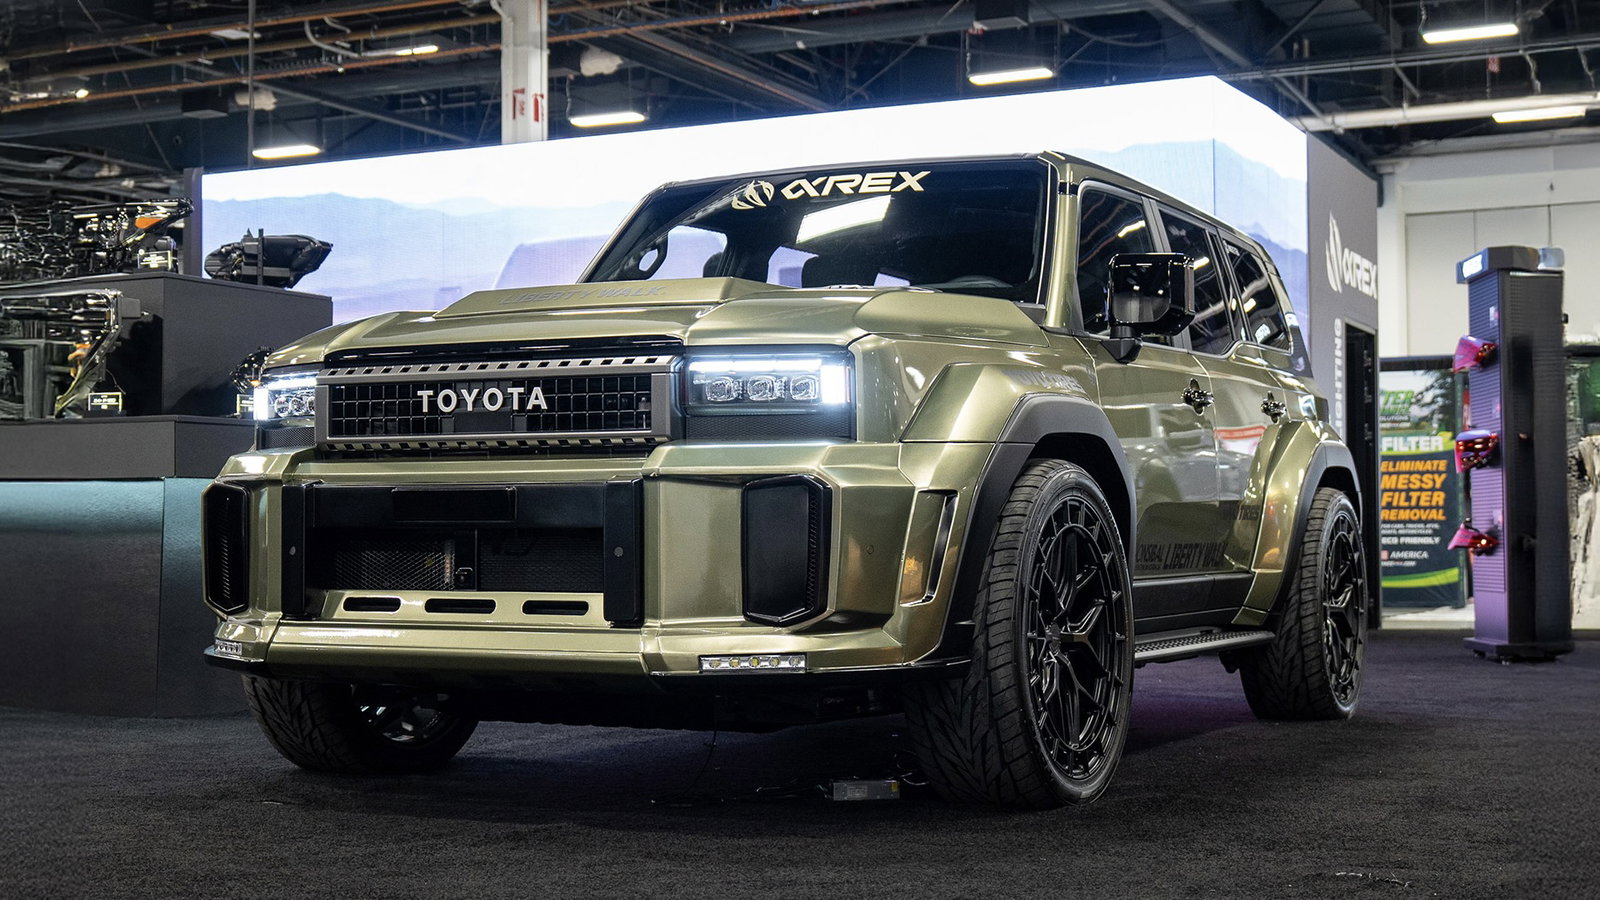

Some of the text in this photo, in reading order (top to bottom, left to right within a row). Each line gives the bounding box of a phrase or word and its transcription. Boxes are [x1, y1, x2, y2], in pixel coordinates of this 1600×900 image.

[500, 285, 668, 306] LIBERTY WALK
[417, 386, 548, 413] TOYOTA
[1381, 436, 1444, 452] FILTER
[1381, 460, 1448, 472] ELIMINATE
[1381, 473, 1448, 489] MESSY
[1381, 491, 1446, 507] FILTER
[1381, 509, 1447, 521] REMOVAL
[1381, 536, 1441, 545] ECO FRIENDLY
[1162, 543, 1205, 570] LIBERTY
[1390, 551, 1429, 560] AMERICA
